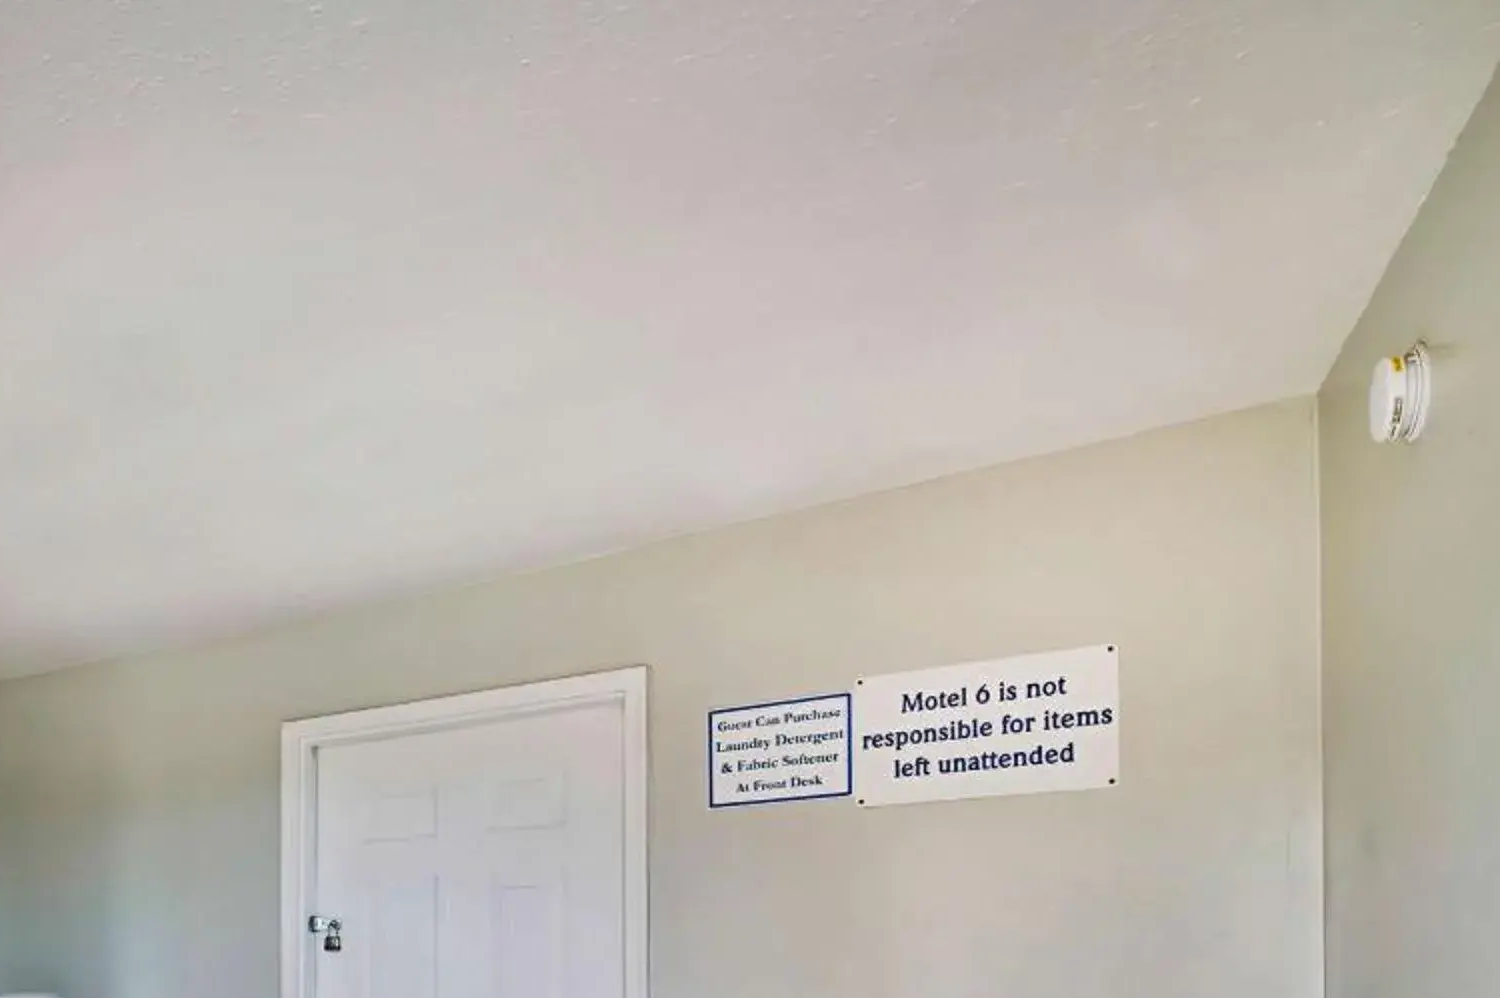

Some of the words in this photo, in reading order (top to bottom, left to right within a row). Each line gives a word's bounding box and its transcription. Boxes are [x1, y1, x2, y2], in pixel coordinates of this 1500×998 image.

[901, 688, 967, 714] Motel
[976, 683, 991, 705] 6
[999, 681, 1017, 702] is
[1027, 677, 1067, 699] not
[717, 720, 752, 732] Guest
[755, 715, 780, 727] Can
[784, 709, 841, 723] Purchase
[862, 719, 993, 751] responsible
[1002, 714, 1036, 735] for
[1043, 707, 1113, 731] items
[716, 738, 770, 752] Laundry
[775, 729, 844, 746] Detergent
[721, 762, 733, 774] &
[737, 758, 779, 772] Fabric
[782, 753, 839, 766] Softener
[894, 758, 931, 779] left
[939, 742, 1075, 774] unattended
[736, 783, 749, 793] At
[753, 779, 787, 791] Front
[790, 775, 823, 787] Desk
